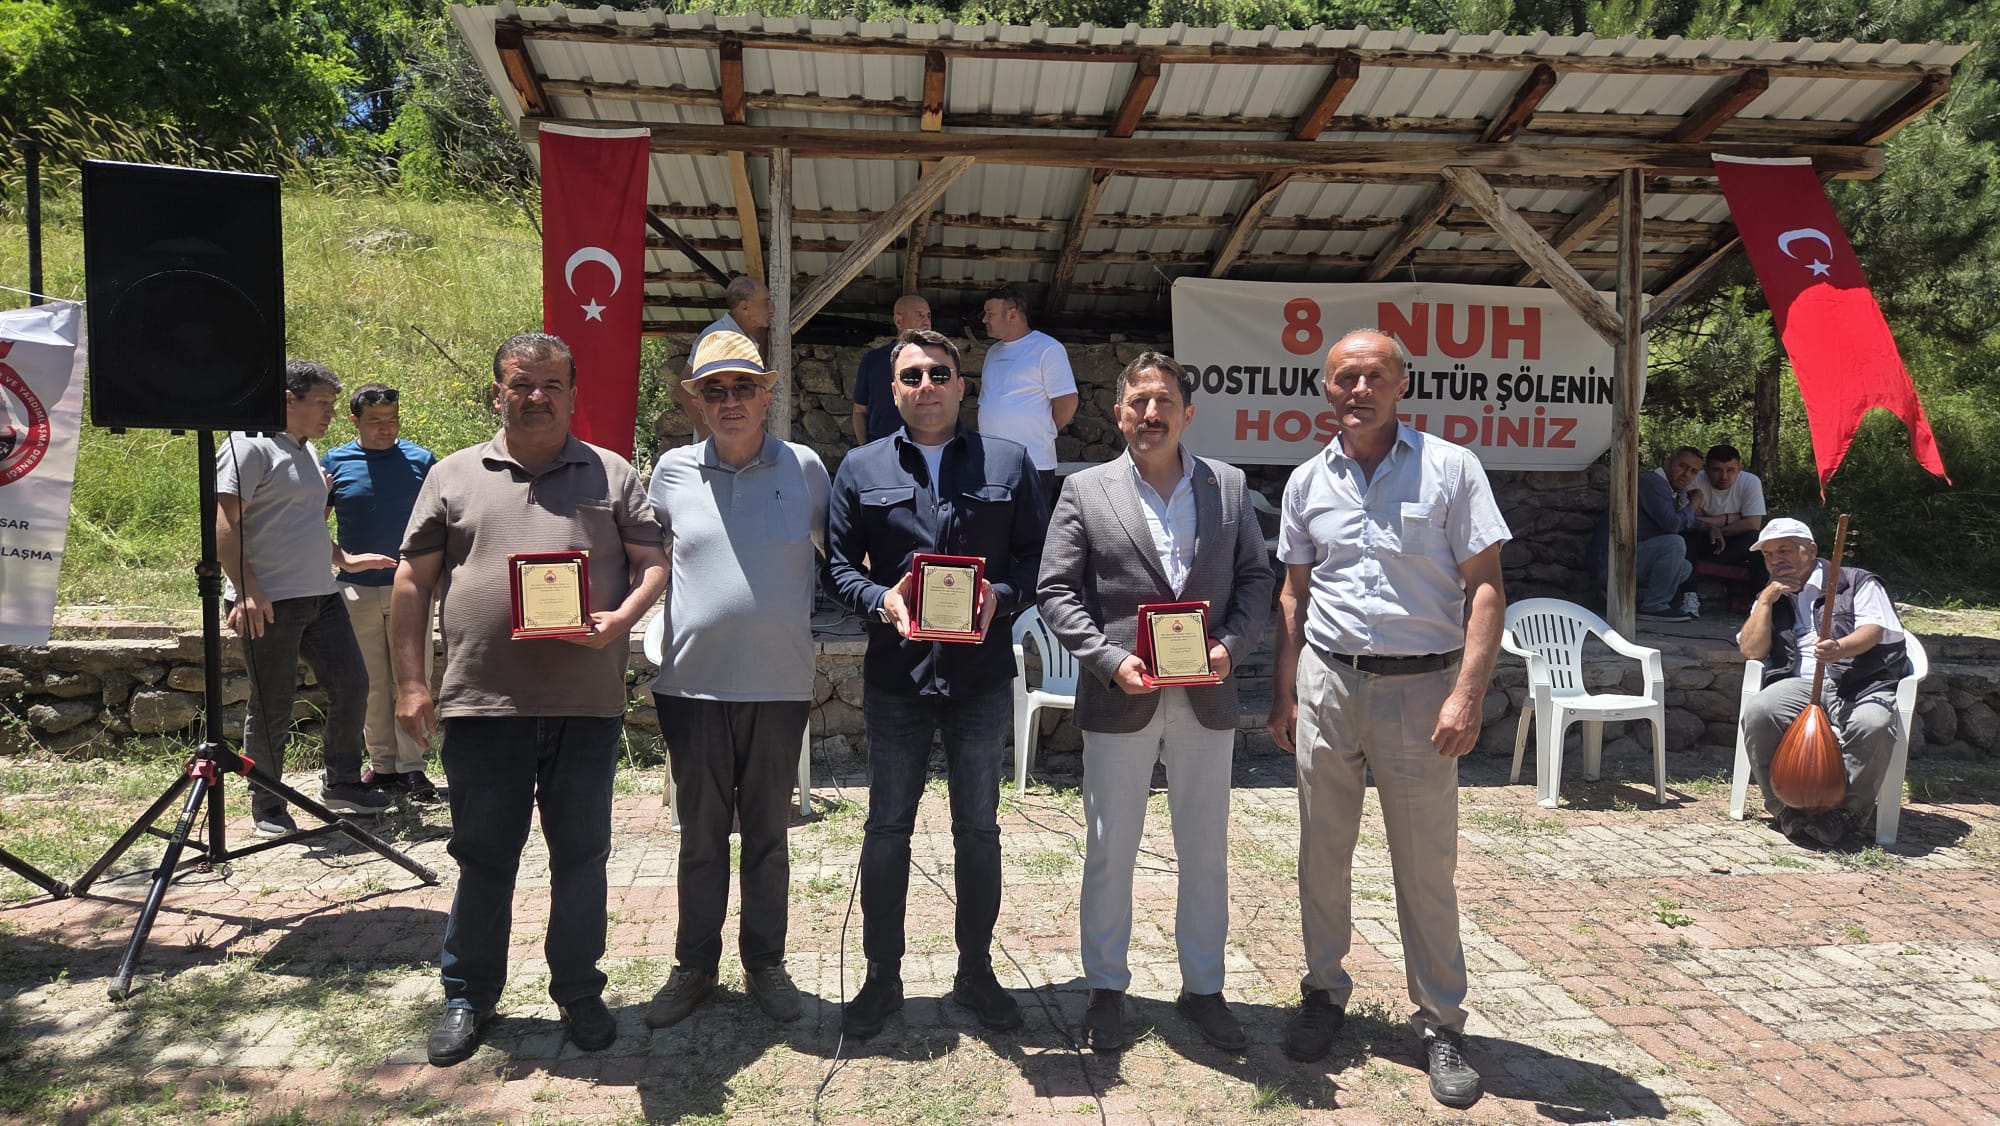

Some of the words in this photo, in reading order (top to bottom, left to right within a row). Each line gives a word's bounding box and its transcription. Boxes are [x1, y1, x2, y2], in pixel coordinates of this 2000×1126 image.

[1281, 297, 1324, 356] 8
[1378, 302, 1541, 361] NUH
[1497, 365, 1614, 411] ŞÖLENİN
[1, 546, 53, 561] LAŞMA
